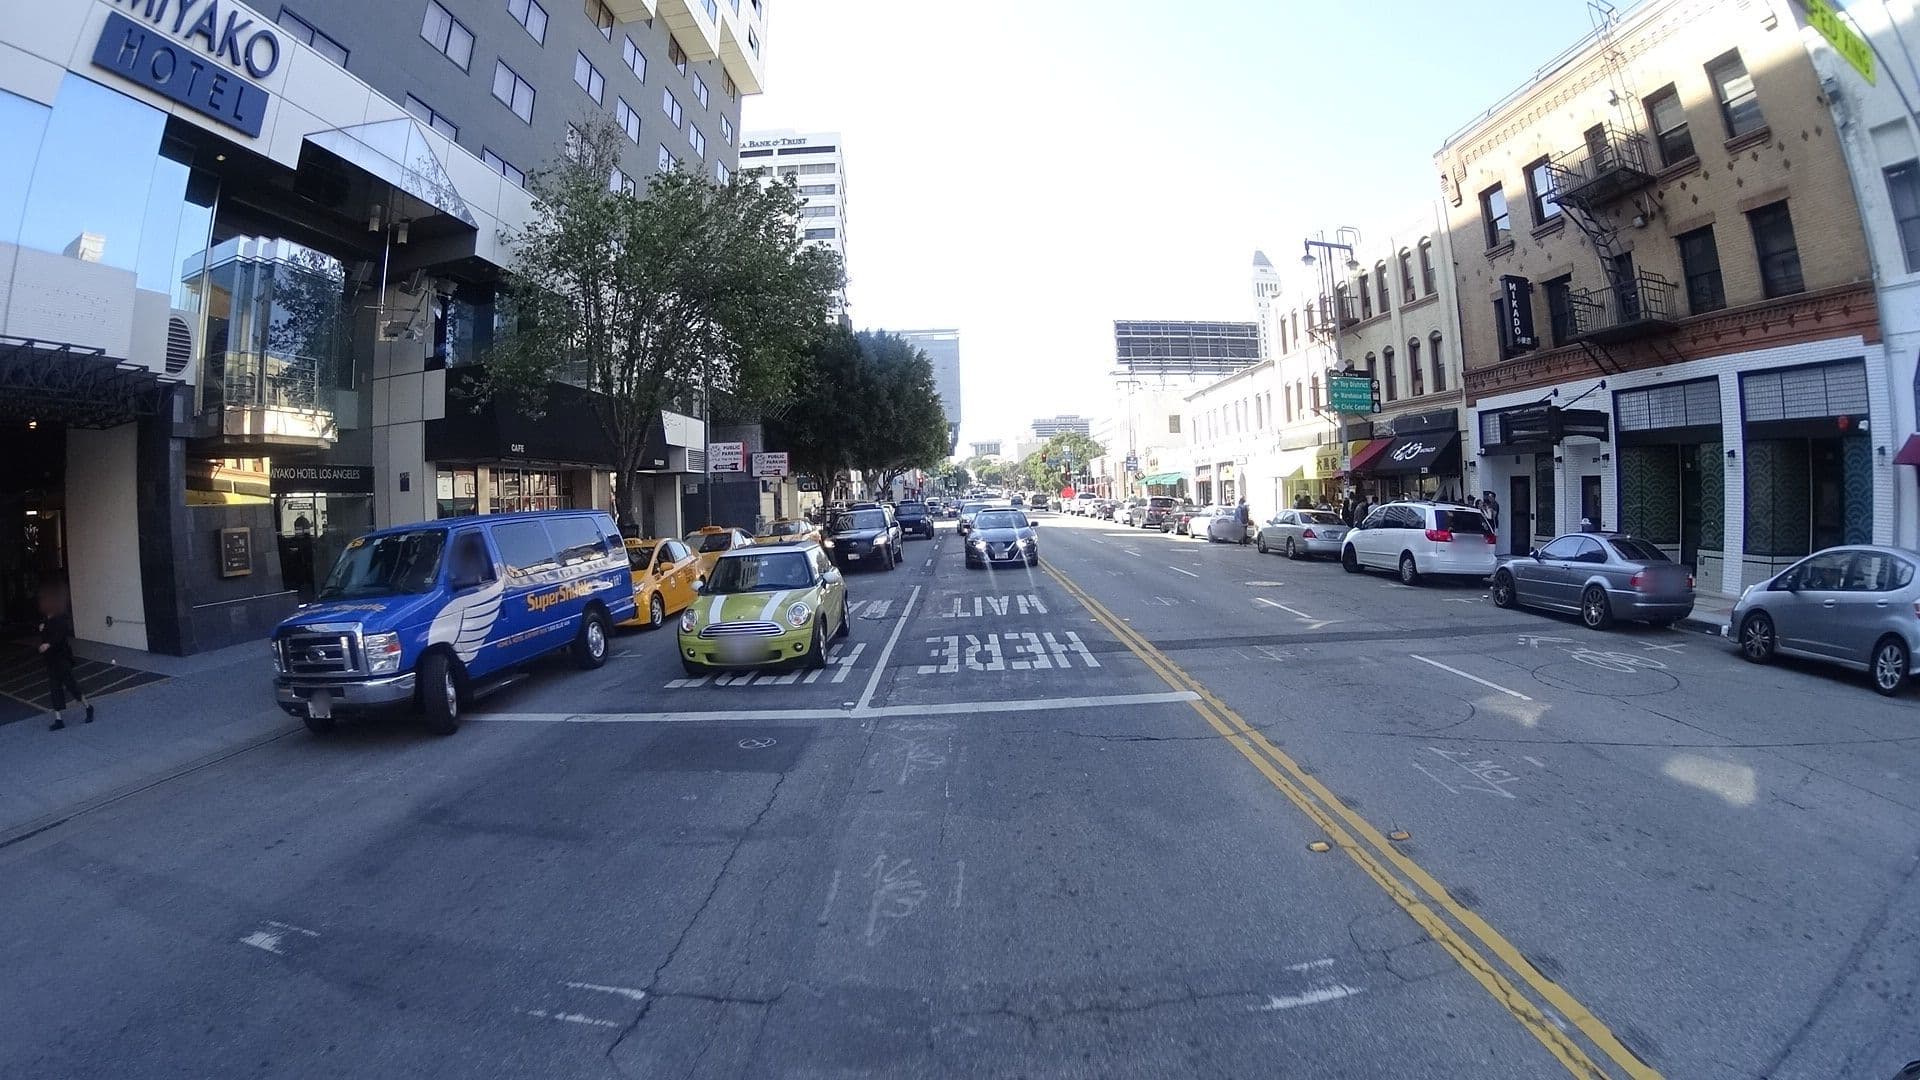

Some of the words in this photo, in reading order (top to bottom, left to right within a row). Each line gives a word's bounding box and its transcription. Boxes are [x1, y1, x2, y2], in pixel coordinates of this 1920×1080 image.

[115, 0, 280, 79] IYAKO
[116, 27, 243, 122] HOTEL
[1508, 282, 1521, 335] MIKADO
[511, 443, 525, 453] CAFE
[296, 468, 318, 479] HOTEL
[319, 468, 332, 479] LOS
[332, 469, 360, 479] ANGELES
[942, 594, 1048, 617] WAIT
[917, 631, 1101, 675] HERE
